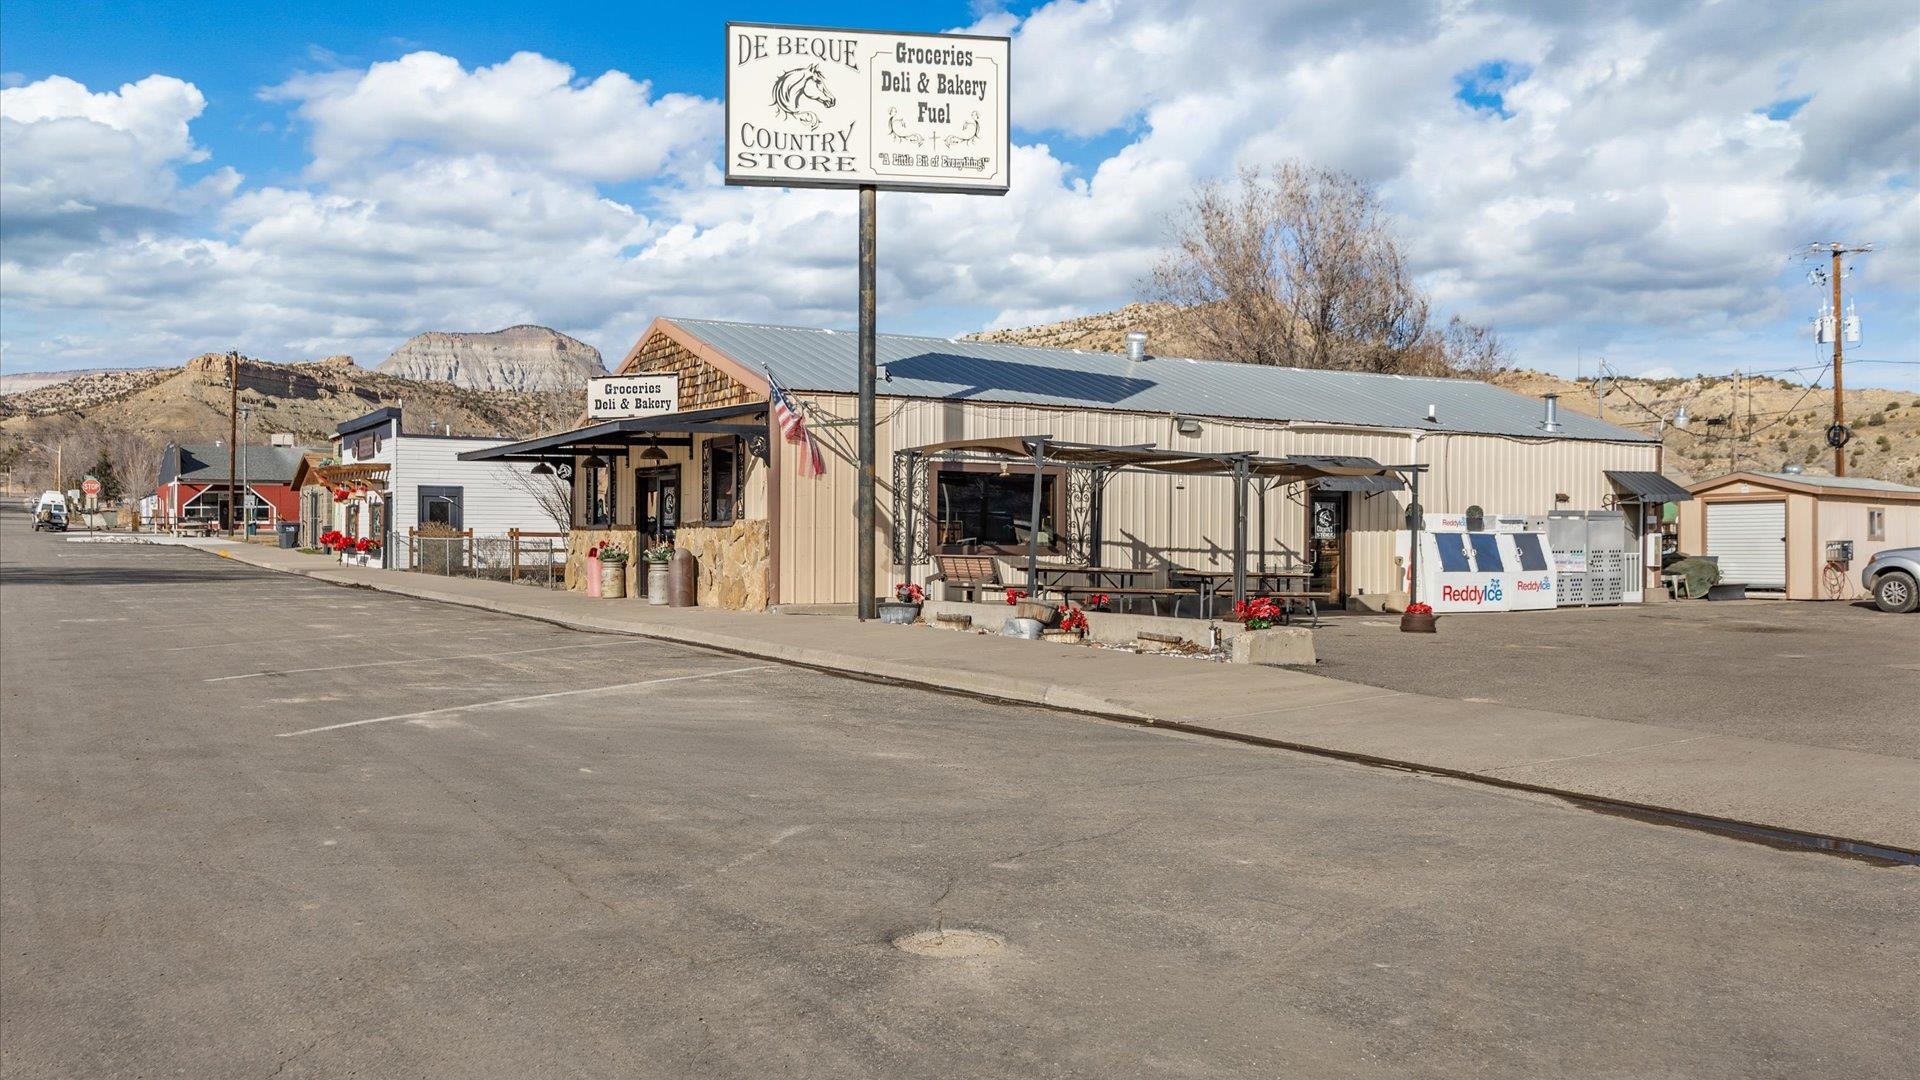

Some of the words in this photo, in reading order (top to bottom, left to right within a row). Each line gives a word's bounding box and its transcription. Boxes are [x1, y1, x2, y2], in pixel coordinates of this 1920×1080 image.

[738, 34, 768, 66] DE
[777, 36, 859, 71] BEQUE
[896, 42, 973, 66] Groceries
[881, 70, 911, 93] Deli
[917, 72, 930, 94] &
[937, 73, 987, 101] Bakery
[918, 102, 951, 124] Fuel
[741, 121, 856, 153] COUNTRY
[737, 152, 857, 172] STORE
[892, 153, 914, 167] Little
[916, 154, 929, 167] Bit
[930, 155, 939, 167] of
[605, 383, 661, 395] Groceries
[595, 399, 616, 410] Deli
[620, 398, 630, 410] &
[635, 397, 672, 411] Bakery
